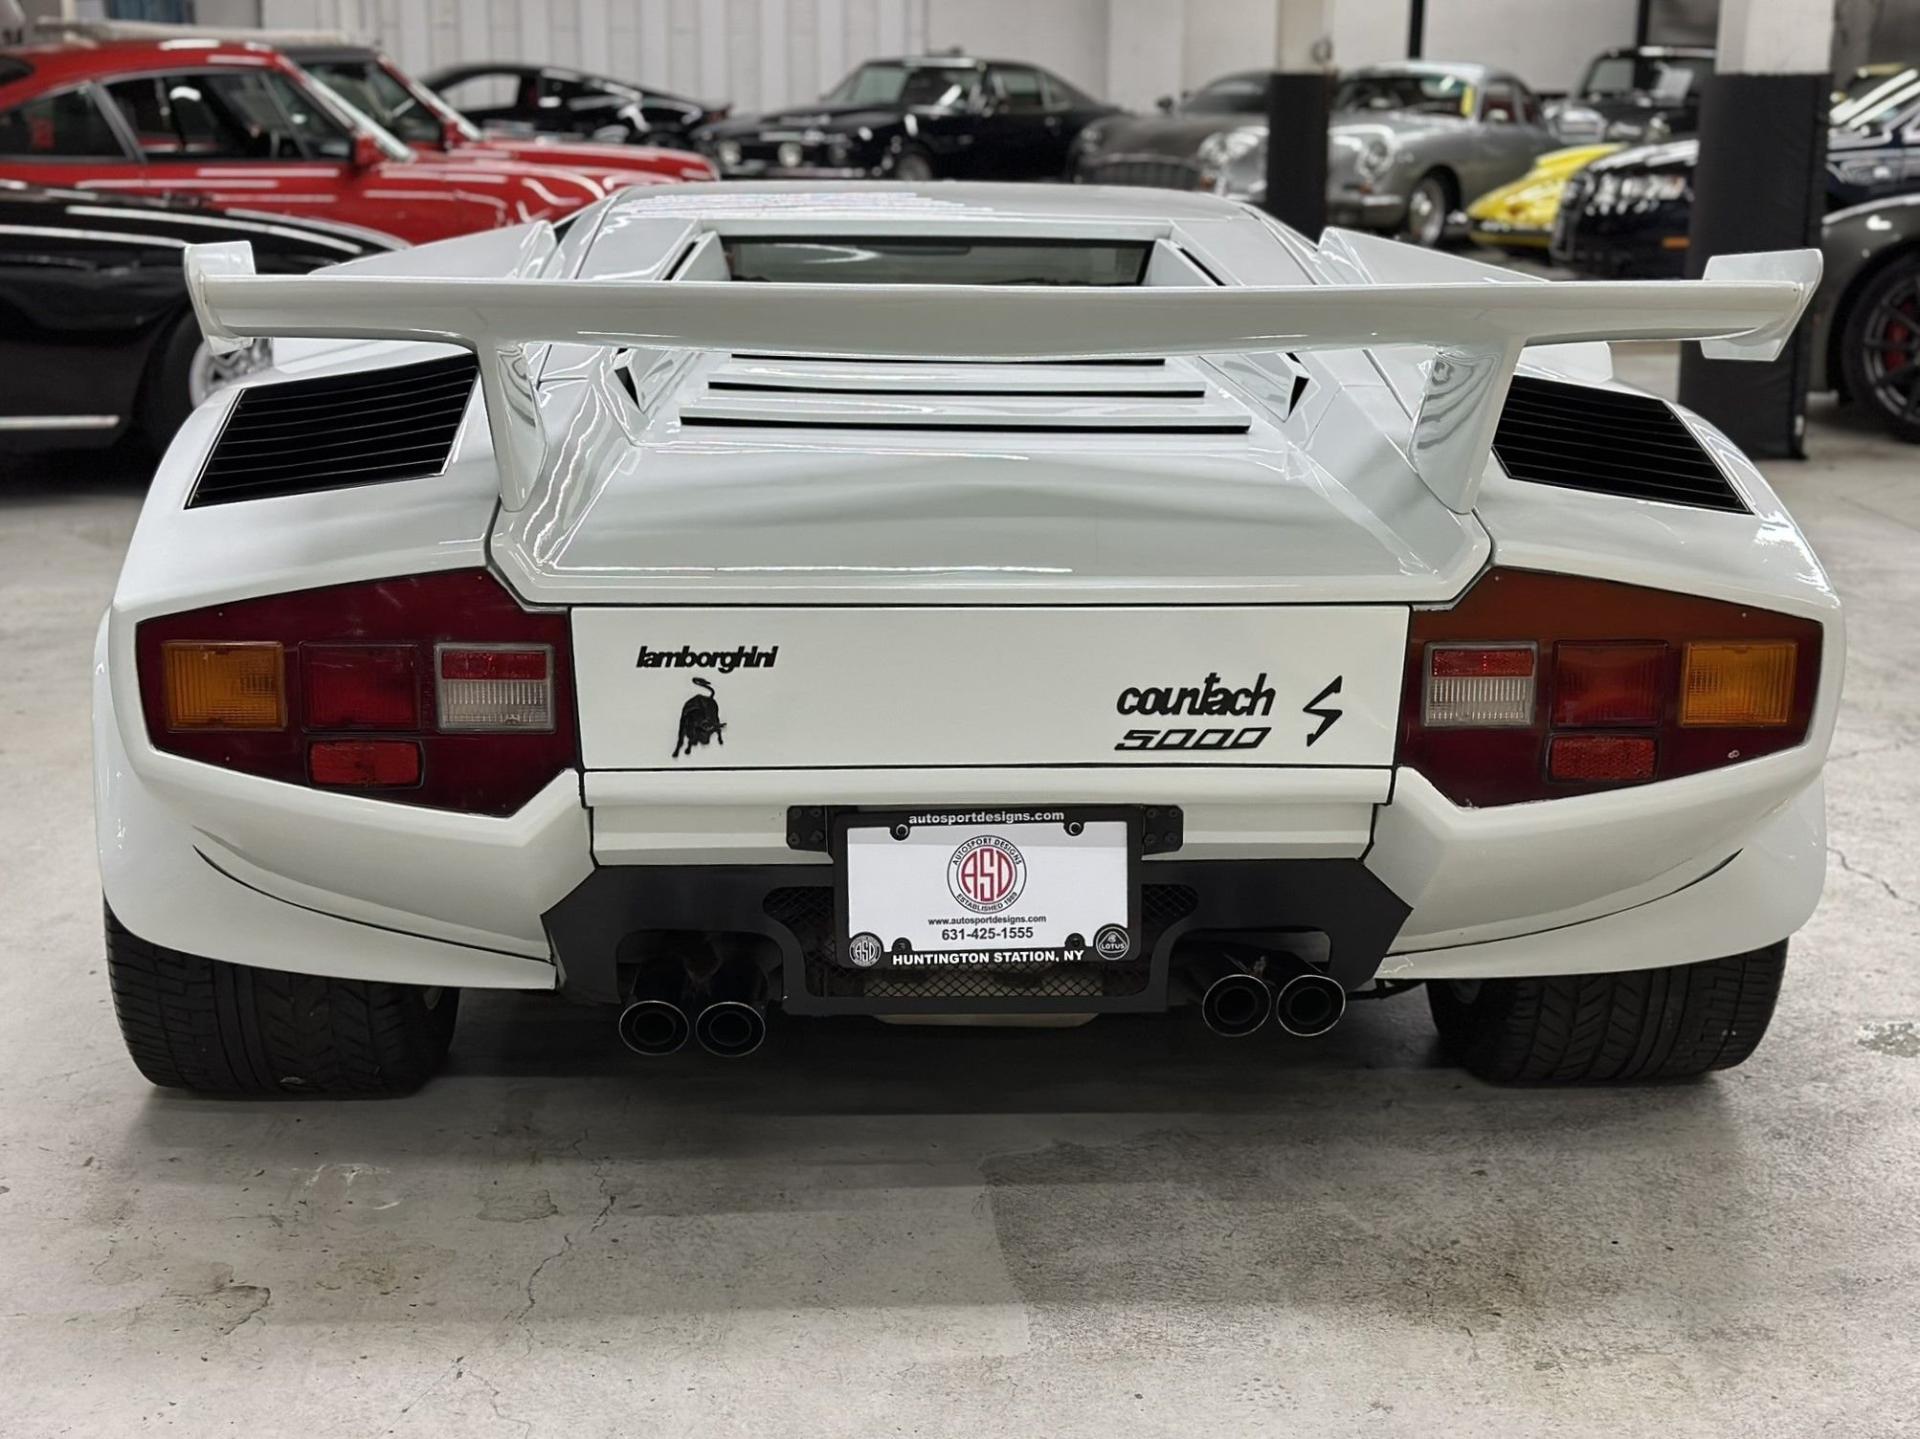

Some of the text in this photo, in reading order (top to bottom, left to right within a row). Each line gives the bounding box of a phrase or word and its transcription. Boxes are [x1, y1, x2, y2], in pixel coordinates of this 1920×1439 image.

[636, 645, 779, 674] lamborghini
[1116, 672, 1276, 716] countach
[1114, 727, 1272, 750] 5000
[908, 810, 1065, 825] autosportdesigns.com
[952, 837, 1022, 866] AUTOSPORT DESIGNS
[961, 848, 1013, 902] ASD
[956, 893, 1004, 912] ESTABLISHED
[927, 915, 1047, 926] www.autosportdesigns.com
[941, 926, 1034, 941] 631-425-1555
[855, 940, 876, 962] ASD
[892, 952, 990, 966] HUNTINGTON
[1063, 950, 1085, 961] NY
